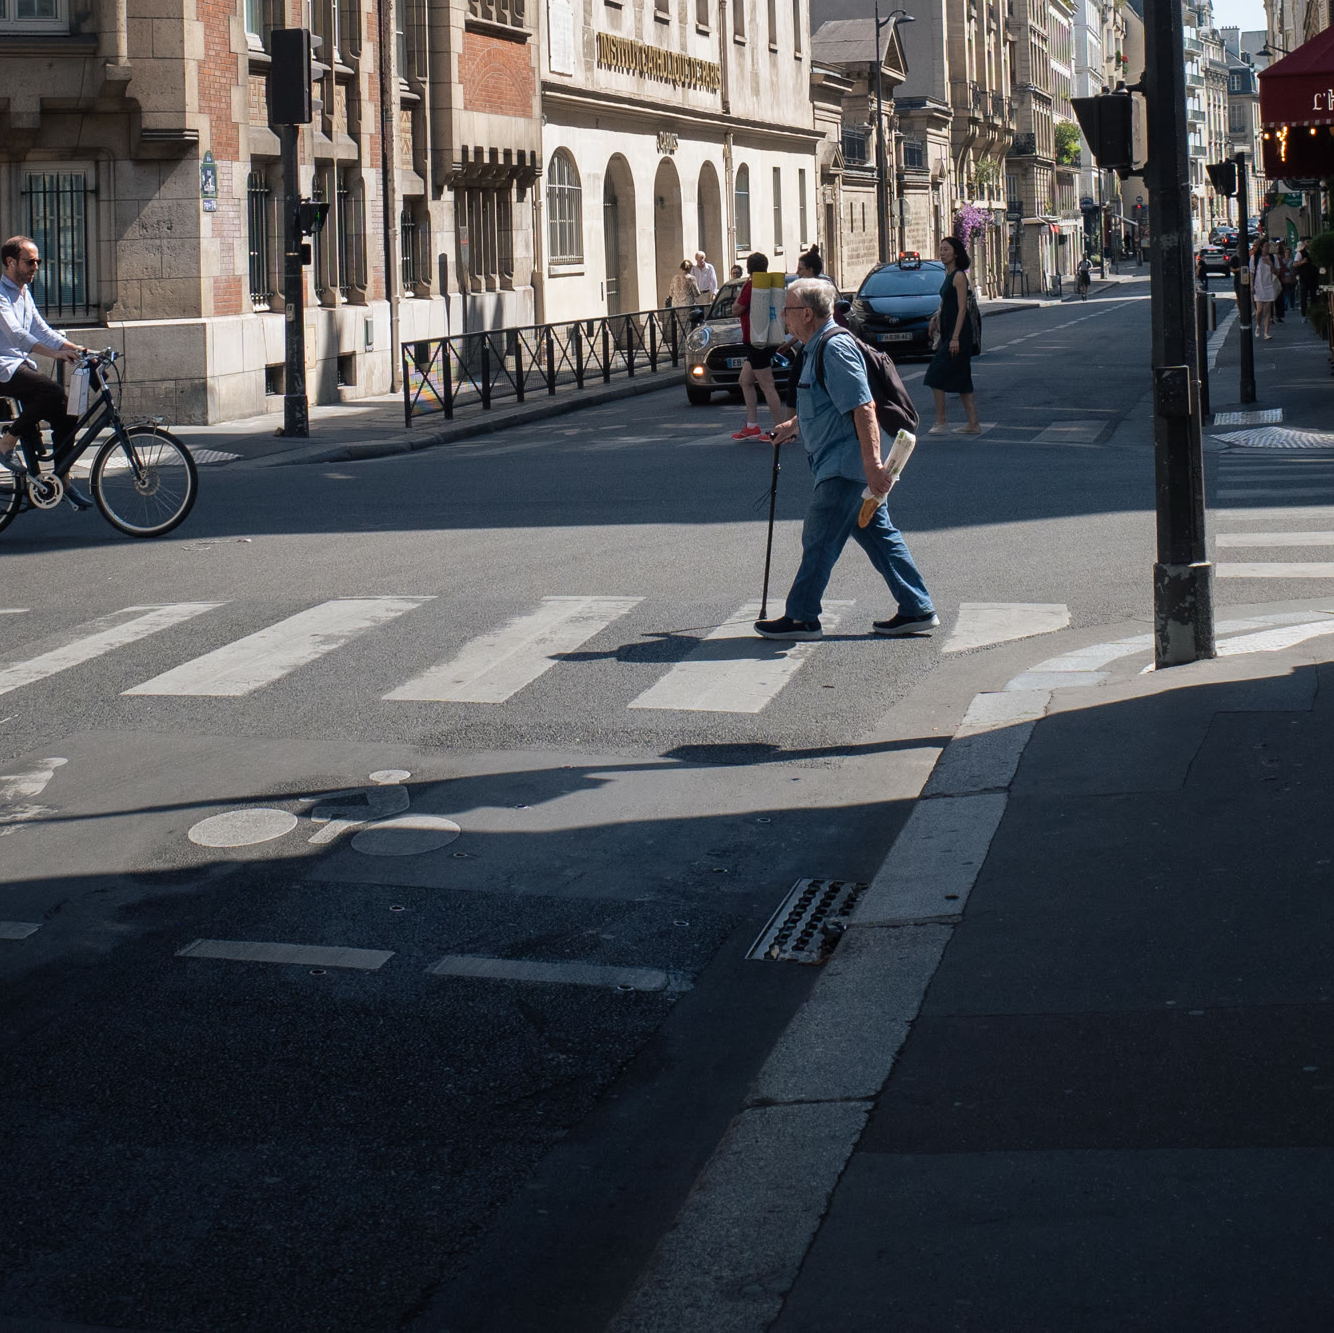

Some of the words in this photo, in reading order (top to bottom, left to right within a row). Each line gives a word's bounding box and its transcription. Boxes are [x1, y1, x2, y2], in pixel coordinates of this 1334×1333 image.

[598, 31, 640, 70] INSTITUT
[641, 43, 689, 87] CATHOLIQUE
[690, 56, 701, 85] DE
[702, 59, 721, 90] PARIS
